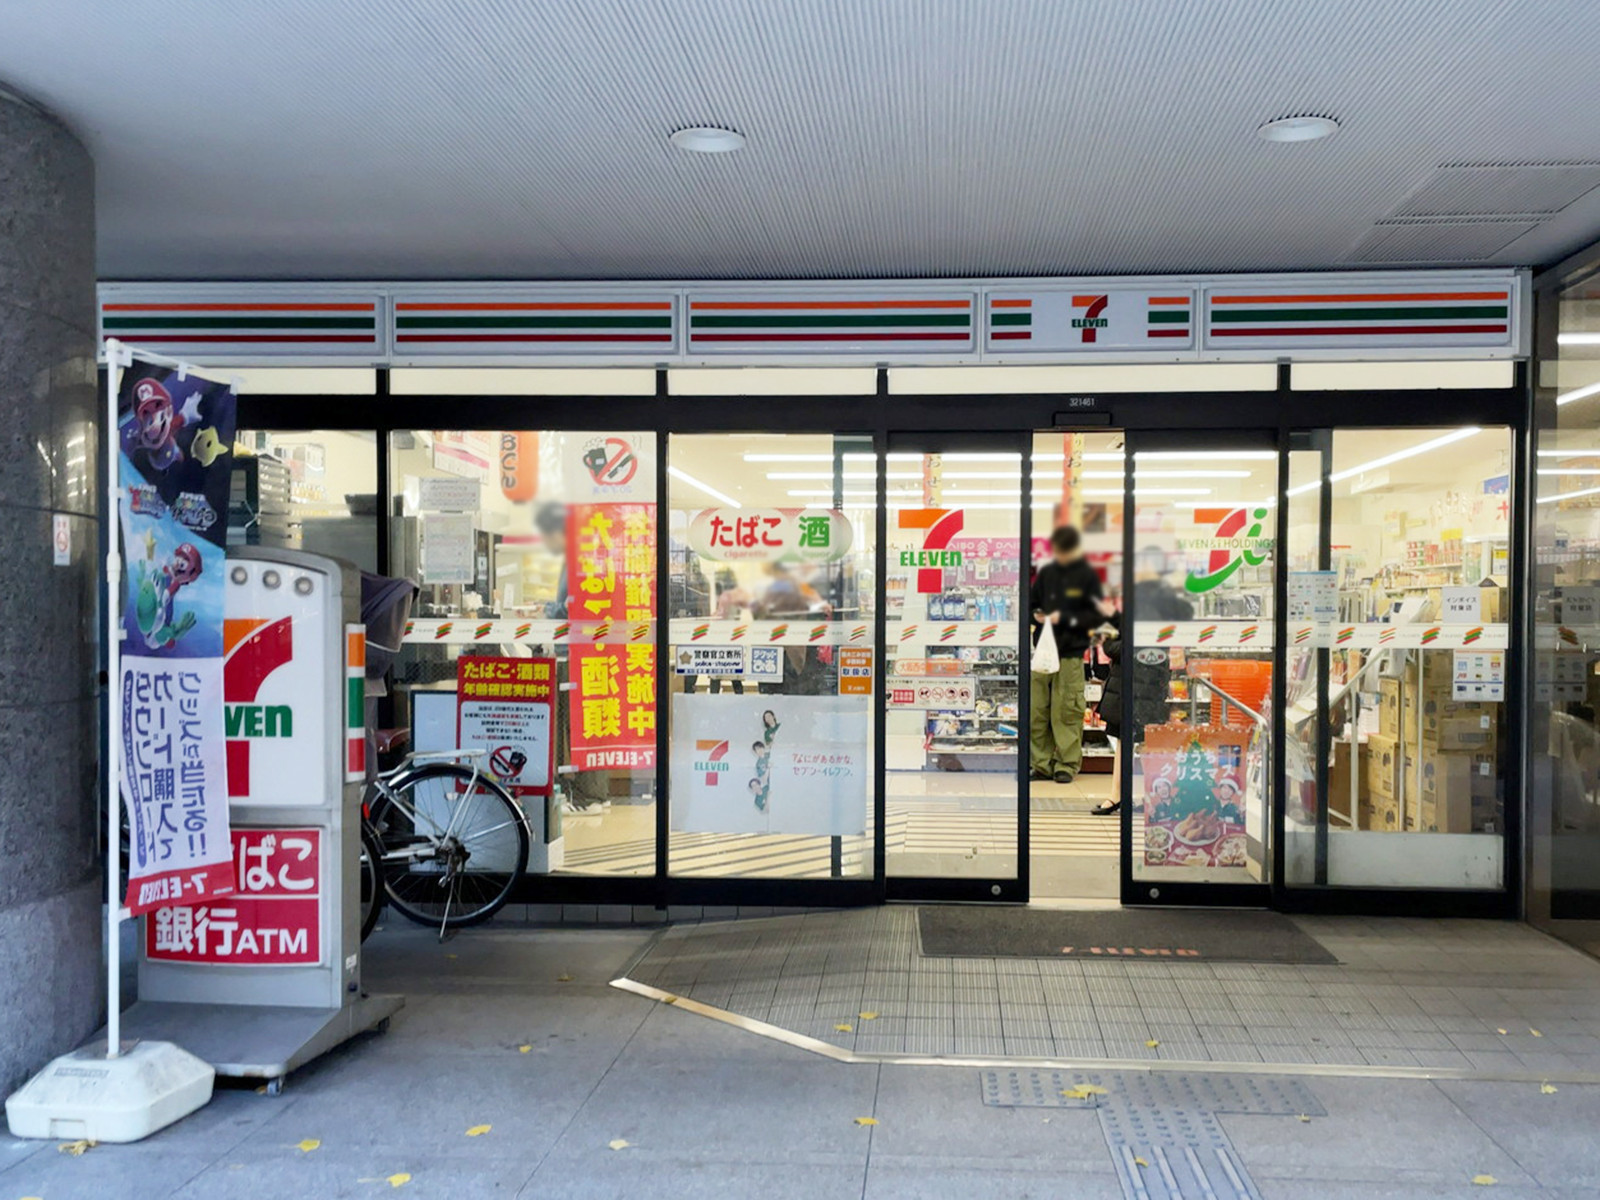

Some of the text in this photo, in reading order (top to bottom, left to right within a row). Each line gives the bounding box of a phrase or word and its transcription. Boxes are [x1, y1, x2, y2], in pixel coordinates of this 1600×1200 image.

[710, 515, 783, 548] たばこ
[798, 516, 830, 547] 酒
[464, 662, 550, 681] たばこ・酒類
[464, 682, 550, 697] 年齢確認実施中
[1174, 746, 1217, 766] おうち
[1160, 763, 1236, 782] クリスマス
[231, 834, 315, 892] ばこ
[155, 907, 308, 955] 銀行ATM
